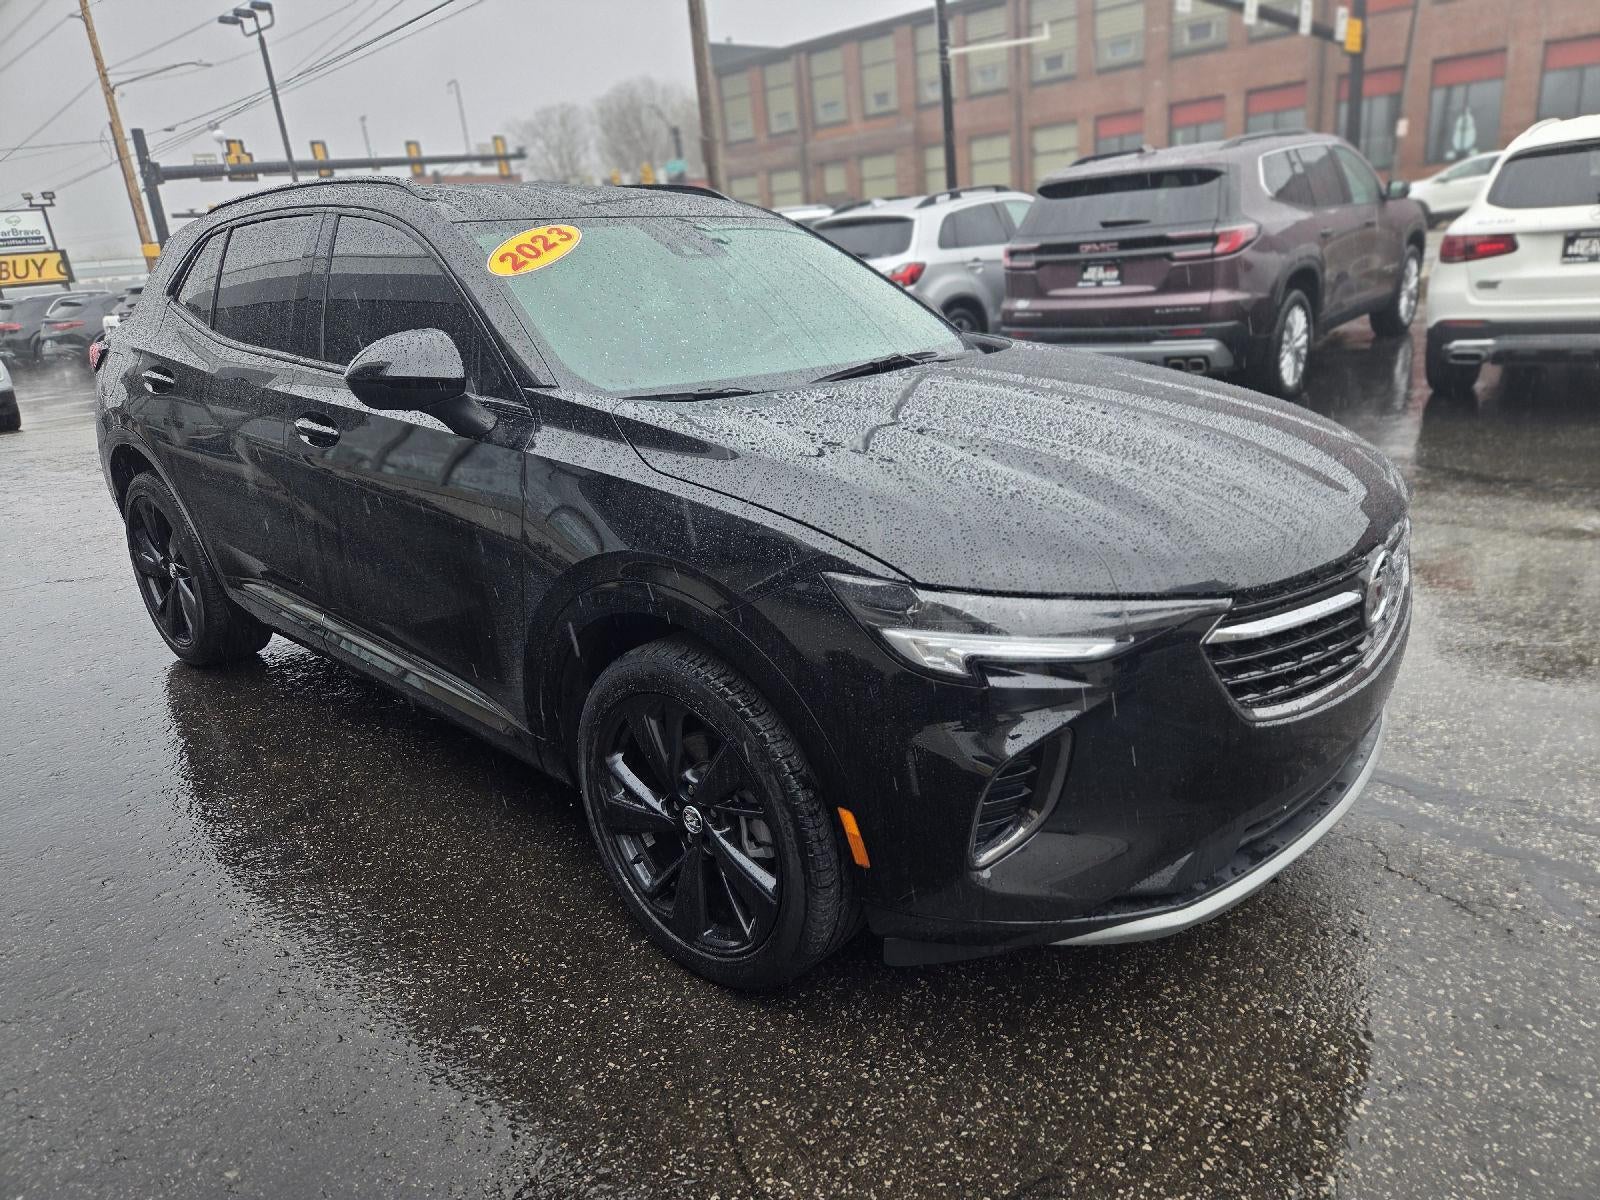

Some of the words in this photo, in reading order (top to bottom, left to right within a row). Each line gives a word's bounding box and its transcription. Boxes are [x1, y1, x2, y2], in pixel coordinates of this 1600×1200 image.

[0, 228, 41, 237] arBravo
[499, 227, 572, 271] 2023
[0, 257, 48, 281] BUY
